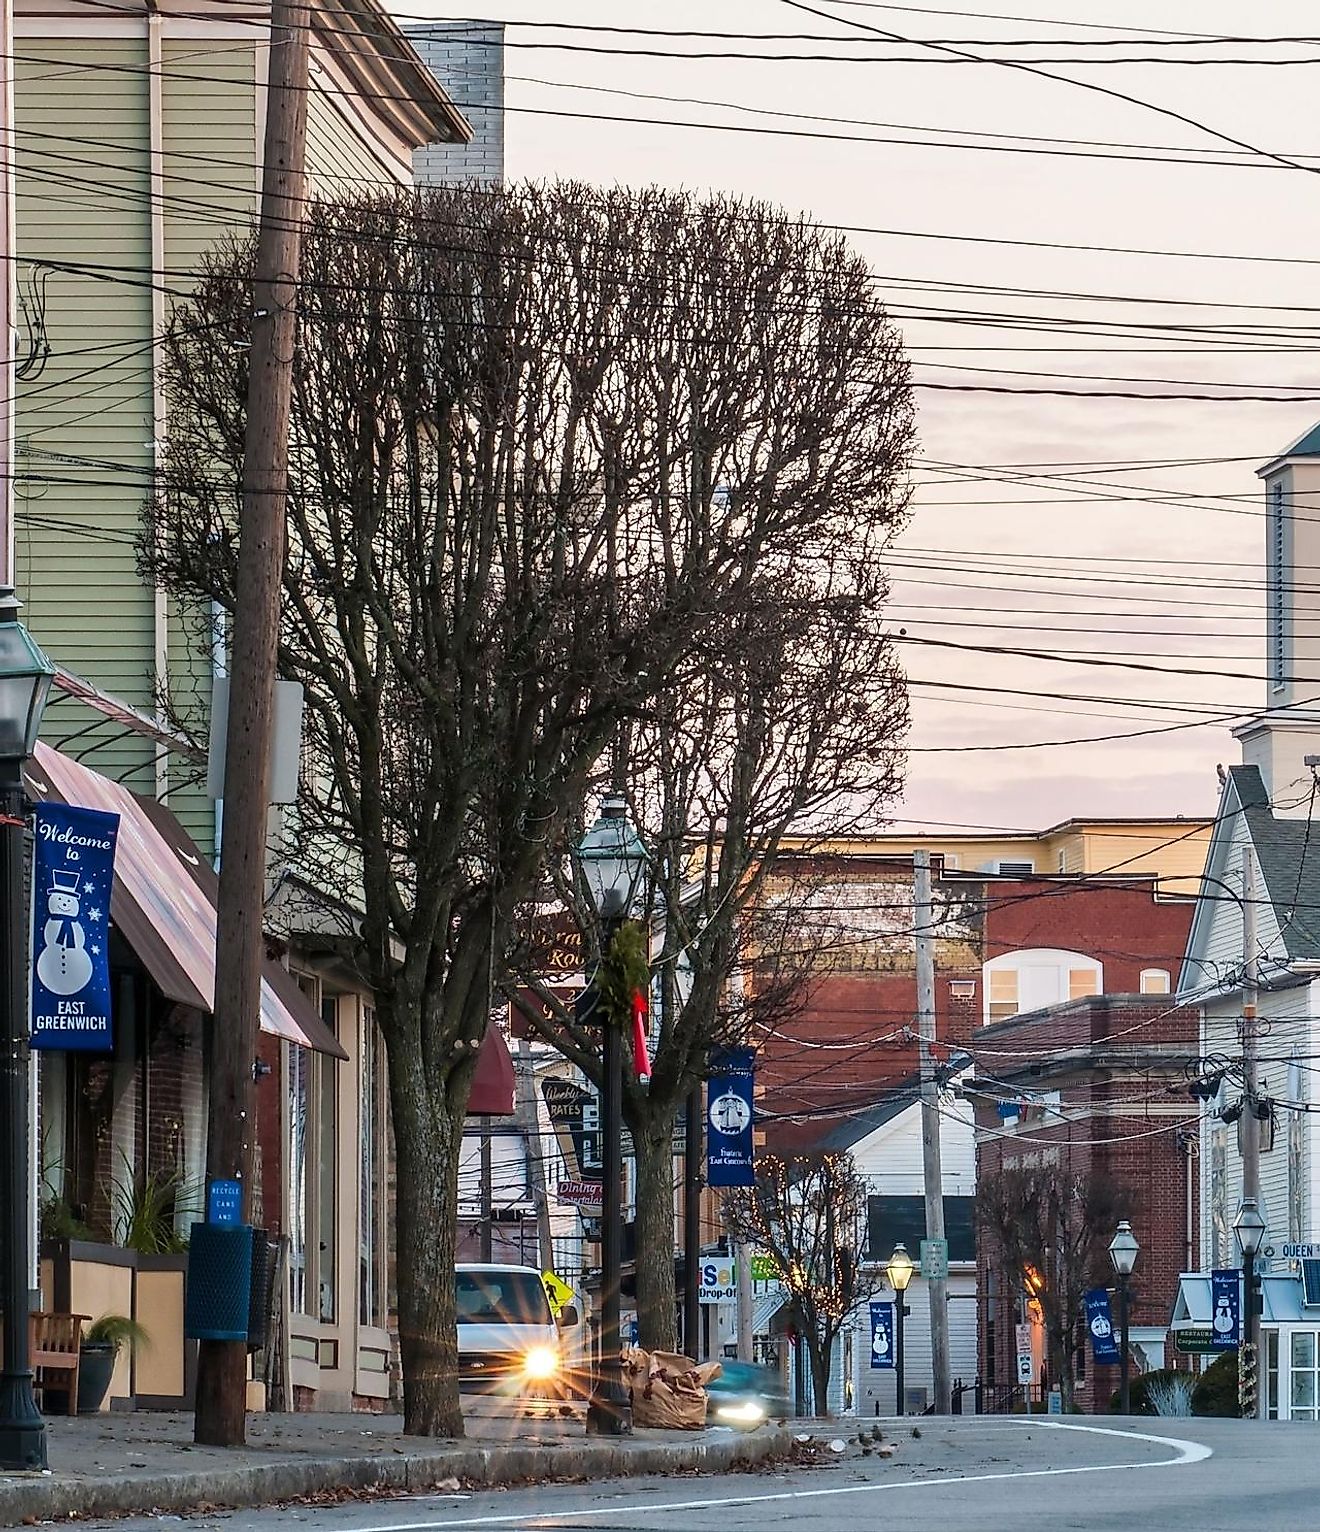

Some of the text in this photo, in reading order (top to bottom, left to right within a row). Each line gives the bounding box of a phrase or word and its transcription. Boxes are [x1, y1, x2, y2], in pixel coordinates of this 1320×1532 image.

[39, 824, 111, 850] Welcome
[66, 846, 81, 861] to
[57, 1001, 85, 1015] EAST
[36, 1016, 107, 1031] GREENWICH
[551, 1104, 581, 1116] RATES
[212, 1187, 239, 1195] RECYCLE
[559, 1182, 597, 1196] Dining
[218, 1213, 232, 1221] AND
[1282, 1244, 1313, 1257] QUEEN
